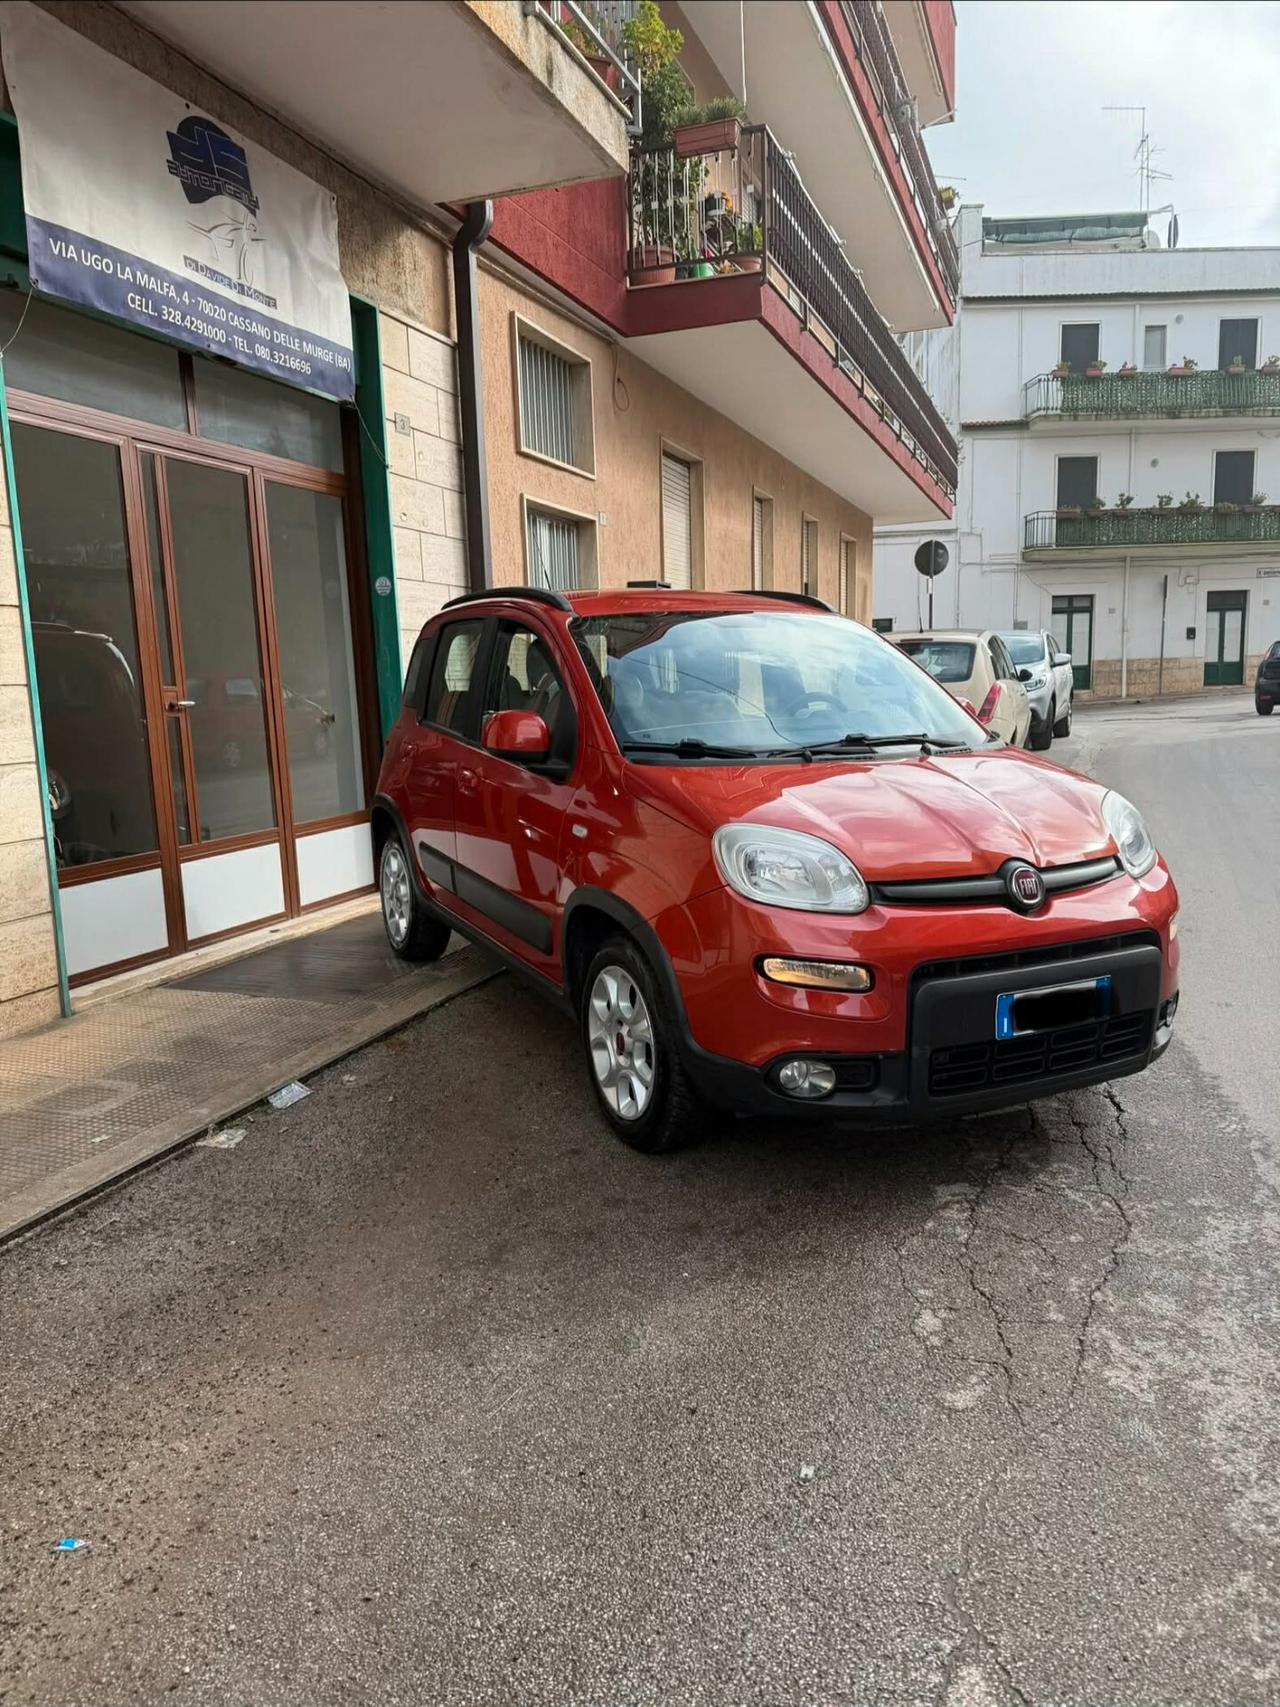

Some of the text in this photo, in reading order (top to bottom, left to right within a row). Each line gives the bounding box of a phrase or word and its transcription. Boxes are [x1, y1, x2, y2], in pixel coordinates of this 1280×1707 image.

[48, 237, 79, 261] VIA
[81, 249, 114, 274] UGO
[117, 262, 134, 283] LA
[136, 271, 180, 304] MALFA,
[182, 291, 190, 305] 4
[197, 297, 226, 321] 70020
[228, 311, 271, 341] CASSANO
[273, 330, 301, 351] DELLE
[303, 341, 334, 363] MURGE
[335, 352, 351, 373] (BA)
[198, 262, 232, 289] DAVIDE
[244, 286, 276, 308] MONTE
[127, 292, 158, 317] CELL.
[161, 305, 226, 343] 328.4291000
[233, 336, 253, 353] TEL.
[254, 344, 312, 375] 080.3216696
[1018, 878, 1038, 896] FIAT
